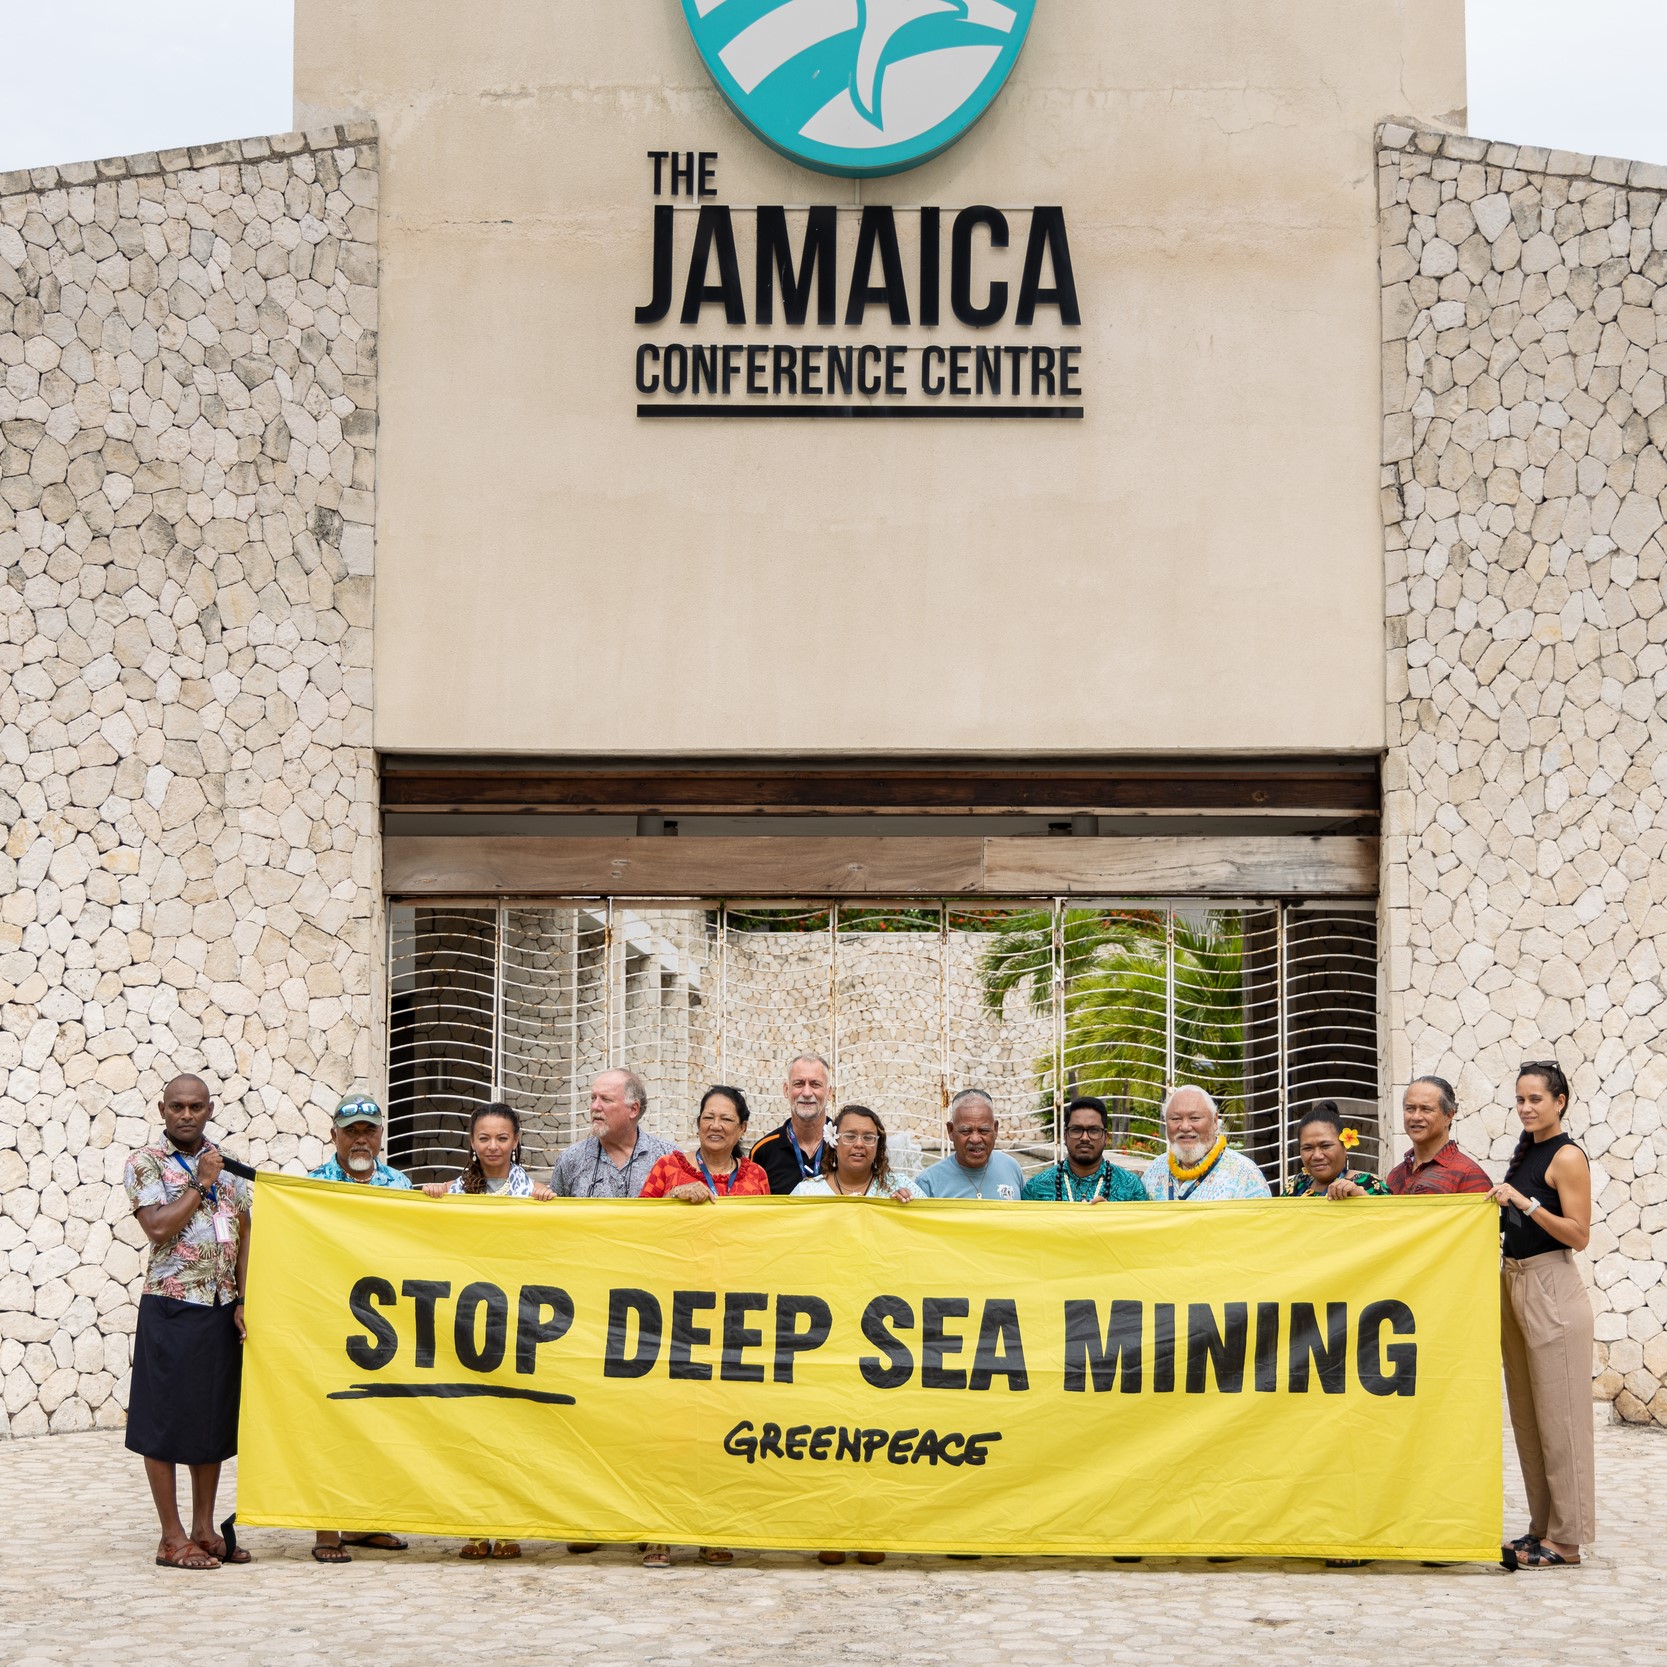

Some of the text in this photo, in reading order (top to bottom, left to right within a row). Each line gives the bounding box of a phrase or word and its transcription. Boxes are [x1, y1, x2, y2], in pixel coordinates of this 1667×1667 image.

[647, 151, 718, 196] THE
[634, 204, 1082, 327] JAMAICA
[635, 343, 1082, 396] CONFERENCE CENTRE
[346, 1276, 1418, 1397] STOP DEEP SEA MINING
[723, 1420, 1003, 1467] GREENPEACE
